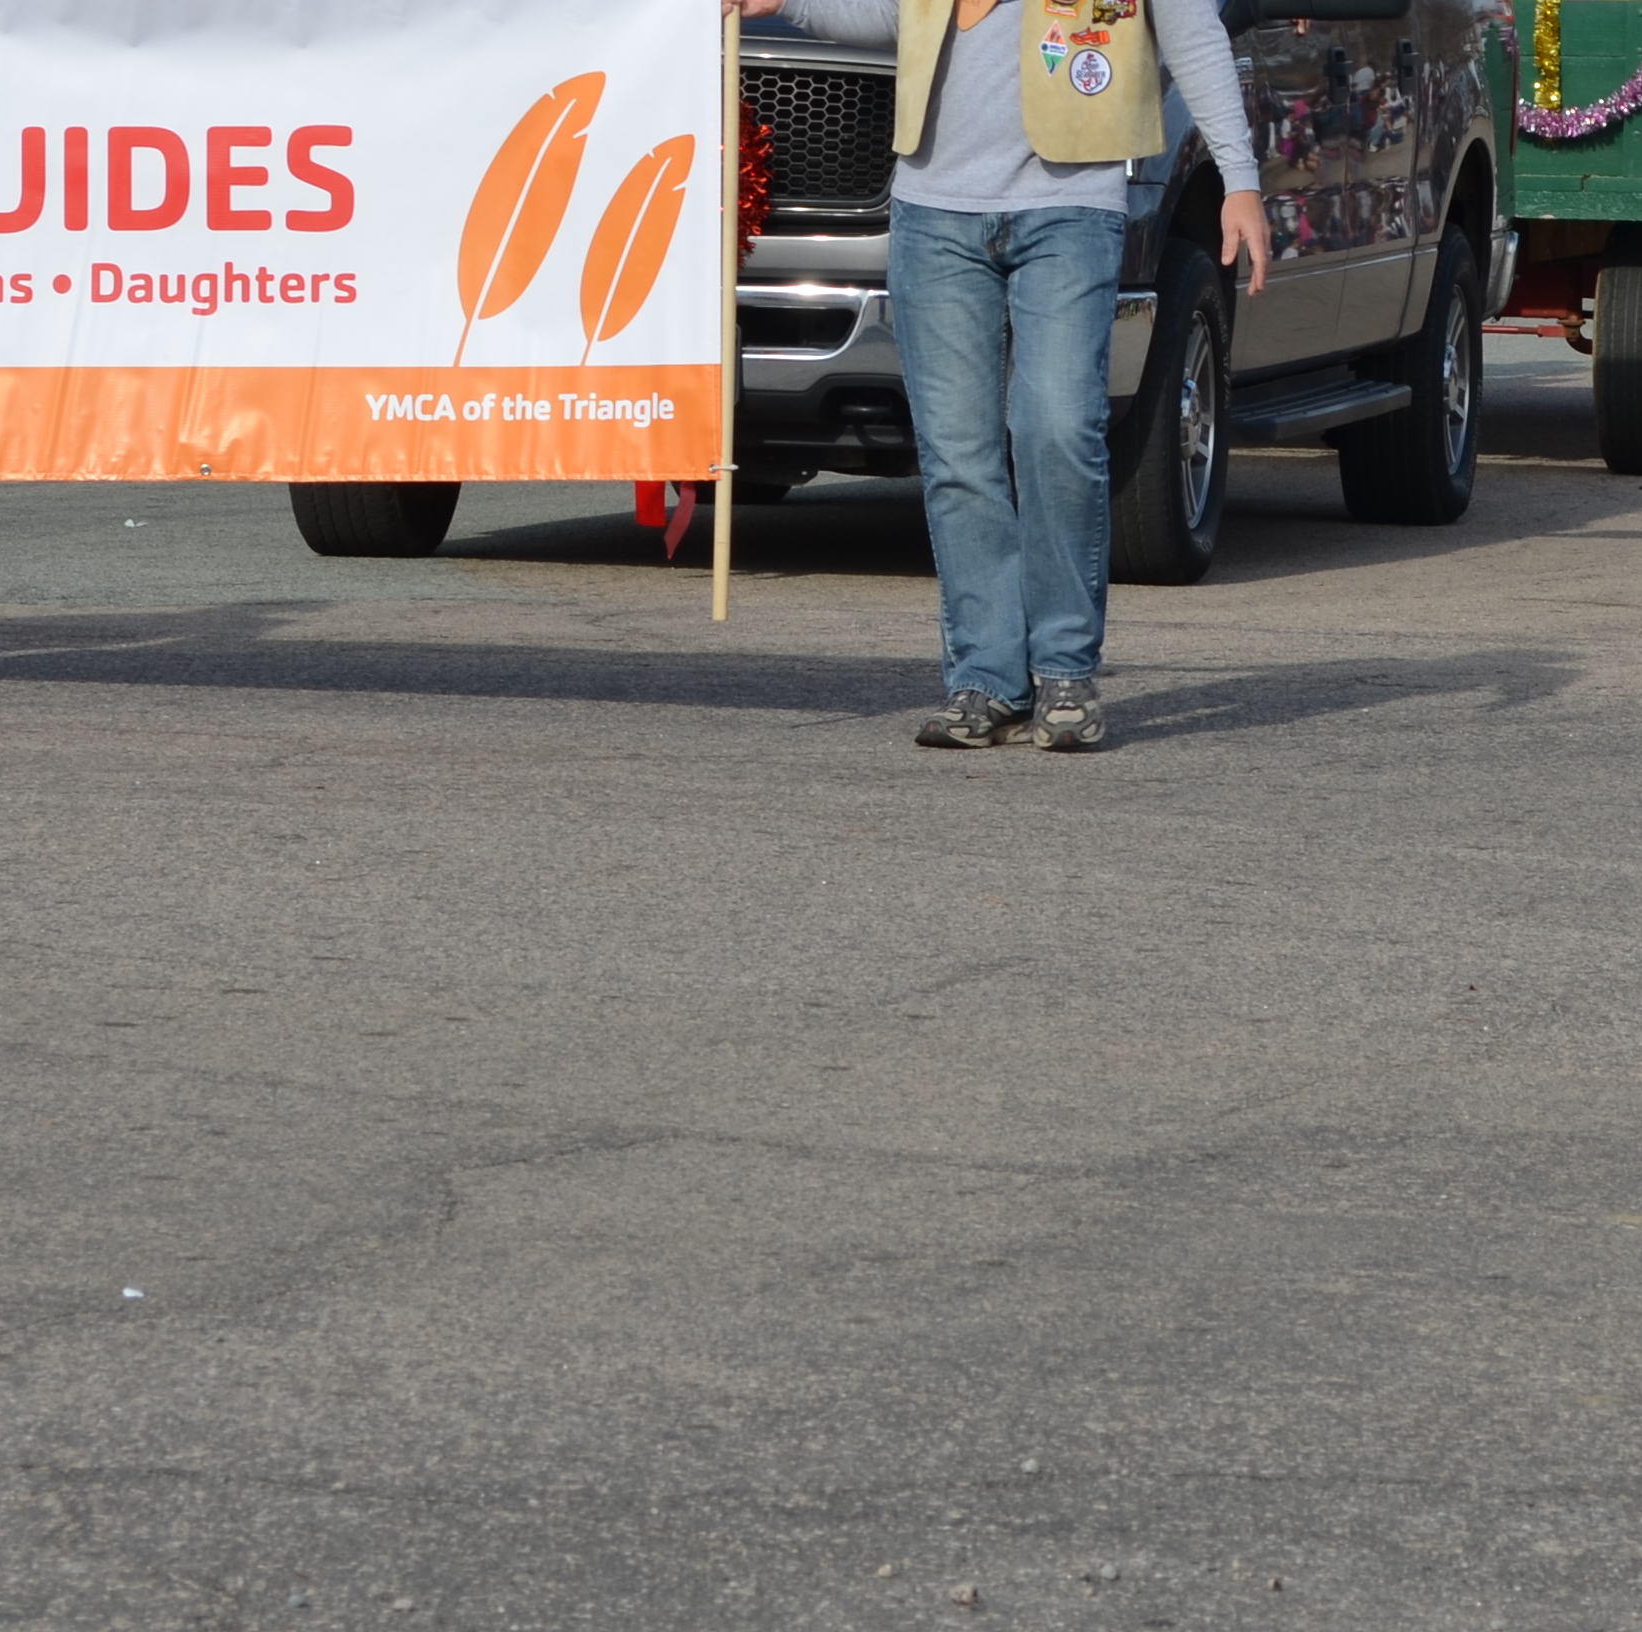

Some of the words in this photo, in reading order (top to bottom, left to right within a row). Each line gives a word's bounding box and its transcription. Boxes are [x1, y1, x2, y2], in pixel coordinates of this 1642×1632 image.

[91, 261, 358, 317] Daughters
[364, 393, 457, 421] YMCA
[462, 392, 497, 421] of
[501, 392, 552, 421] the
[557, 392, 675, 429] Triangle
